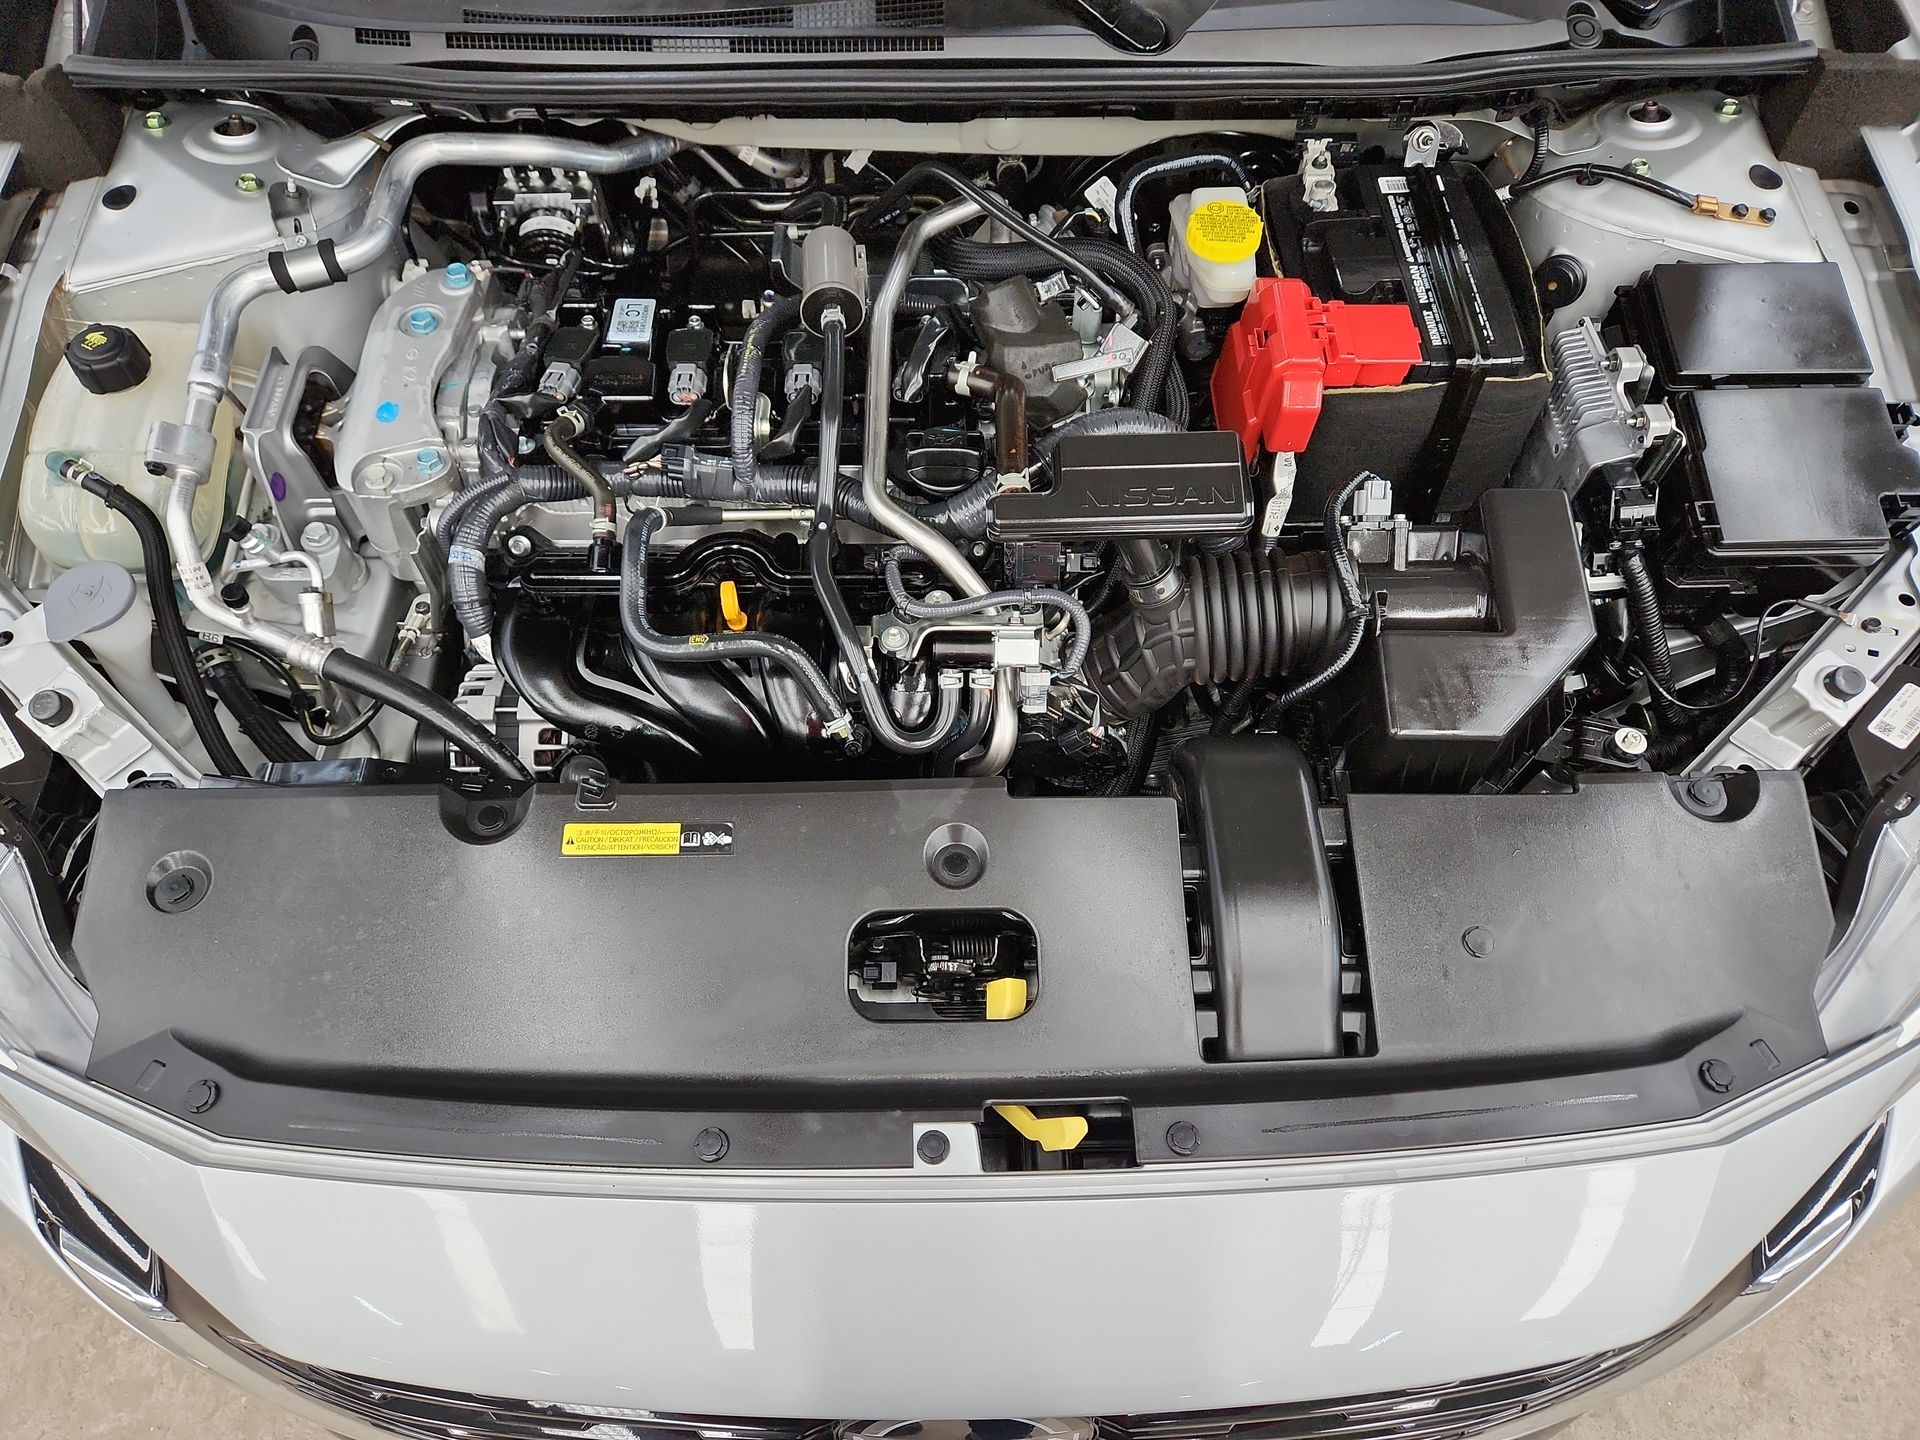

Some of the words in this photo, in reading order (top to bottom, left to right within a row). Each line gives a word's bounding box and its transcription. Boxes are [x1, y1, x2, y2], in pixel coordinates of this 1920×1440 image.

[1409, 265, 1428, 304] NISSAN
[626, 303, 642, 317] LC
[1422, 310, 1443, 346] RENAULT
[1081, 483, 1236, 508] NISSAN
